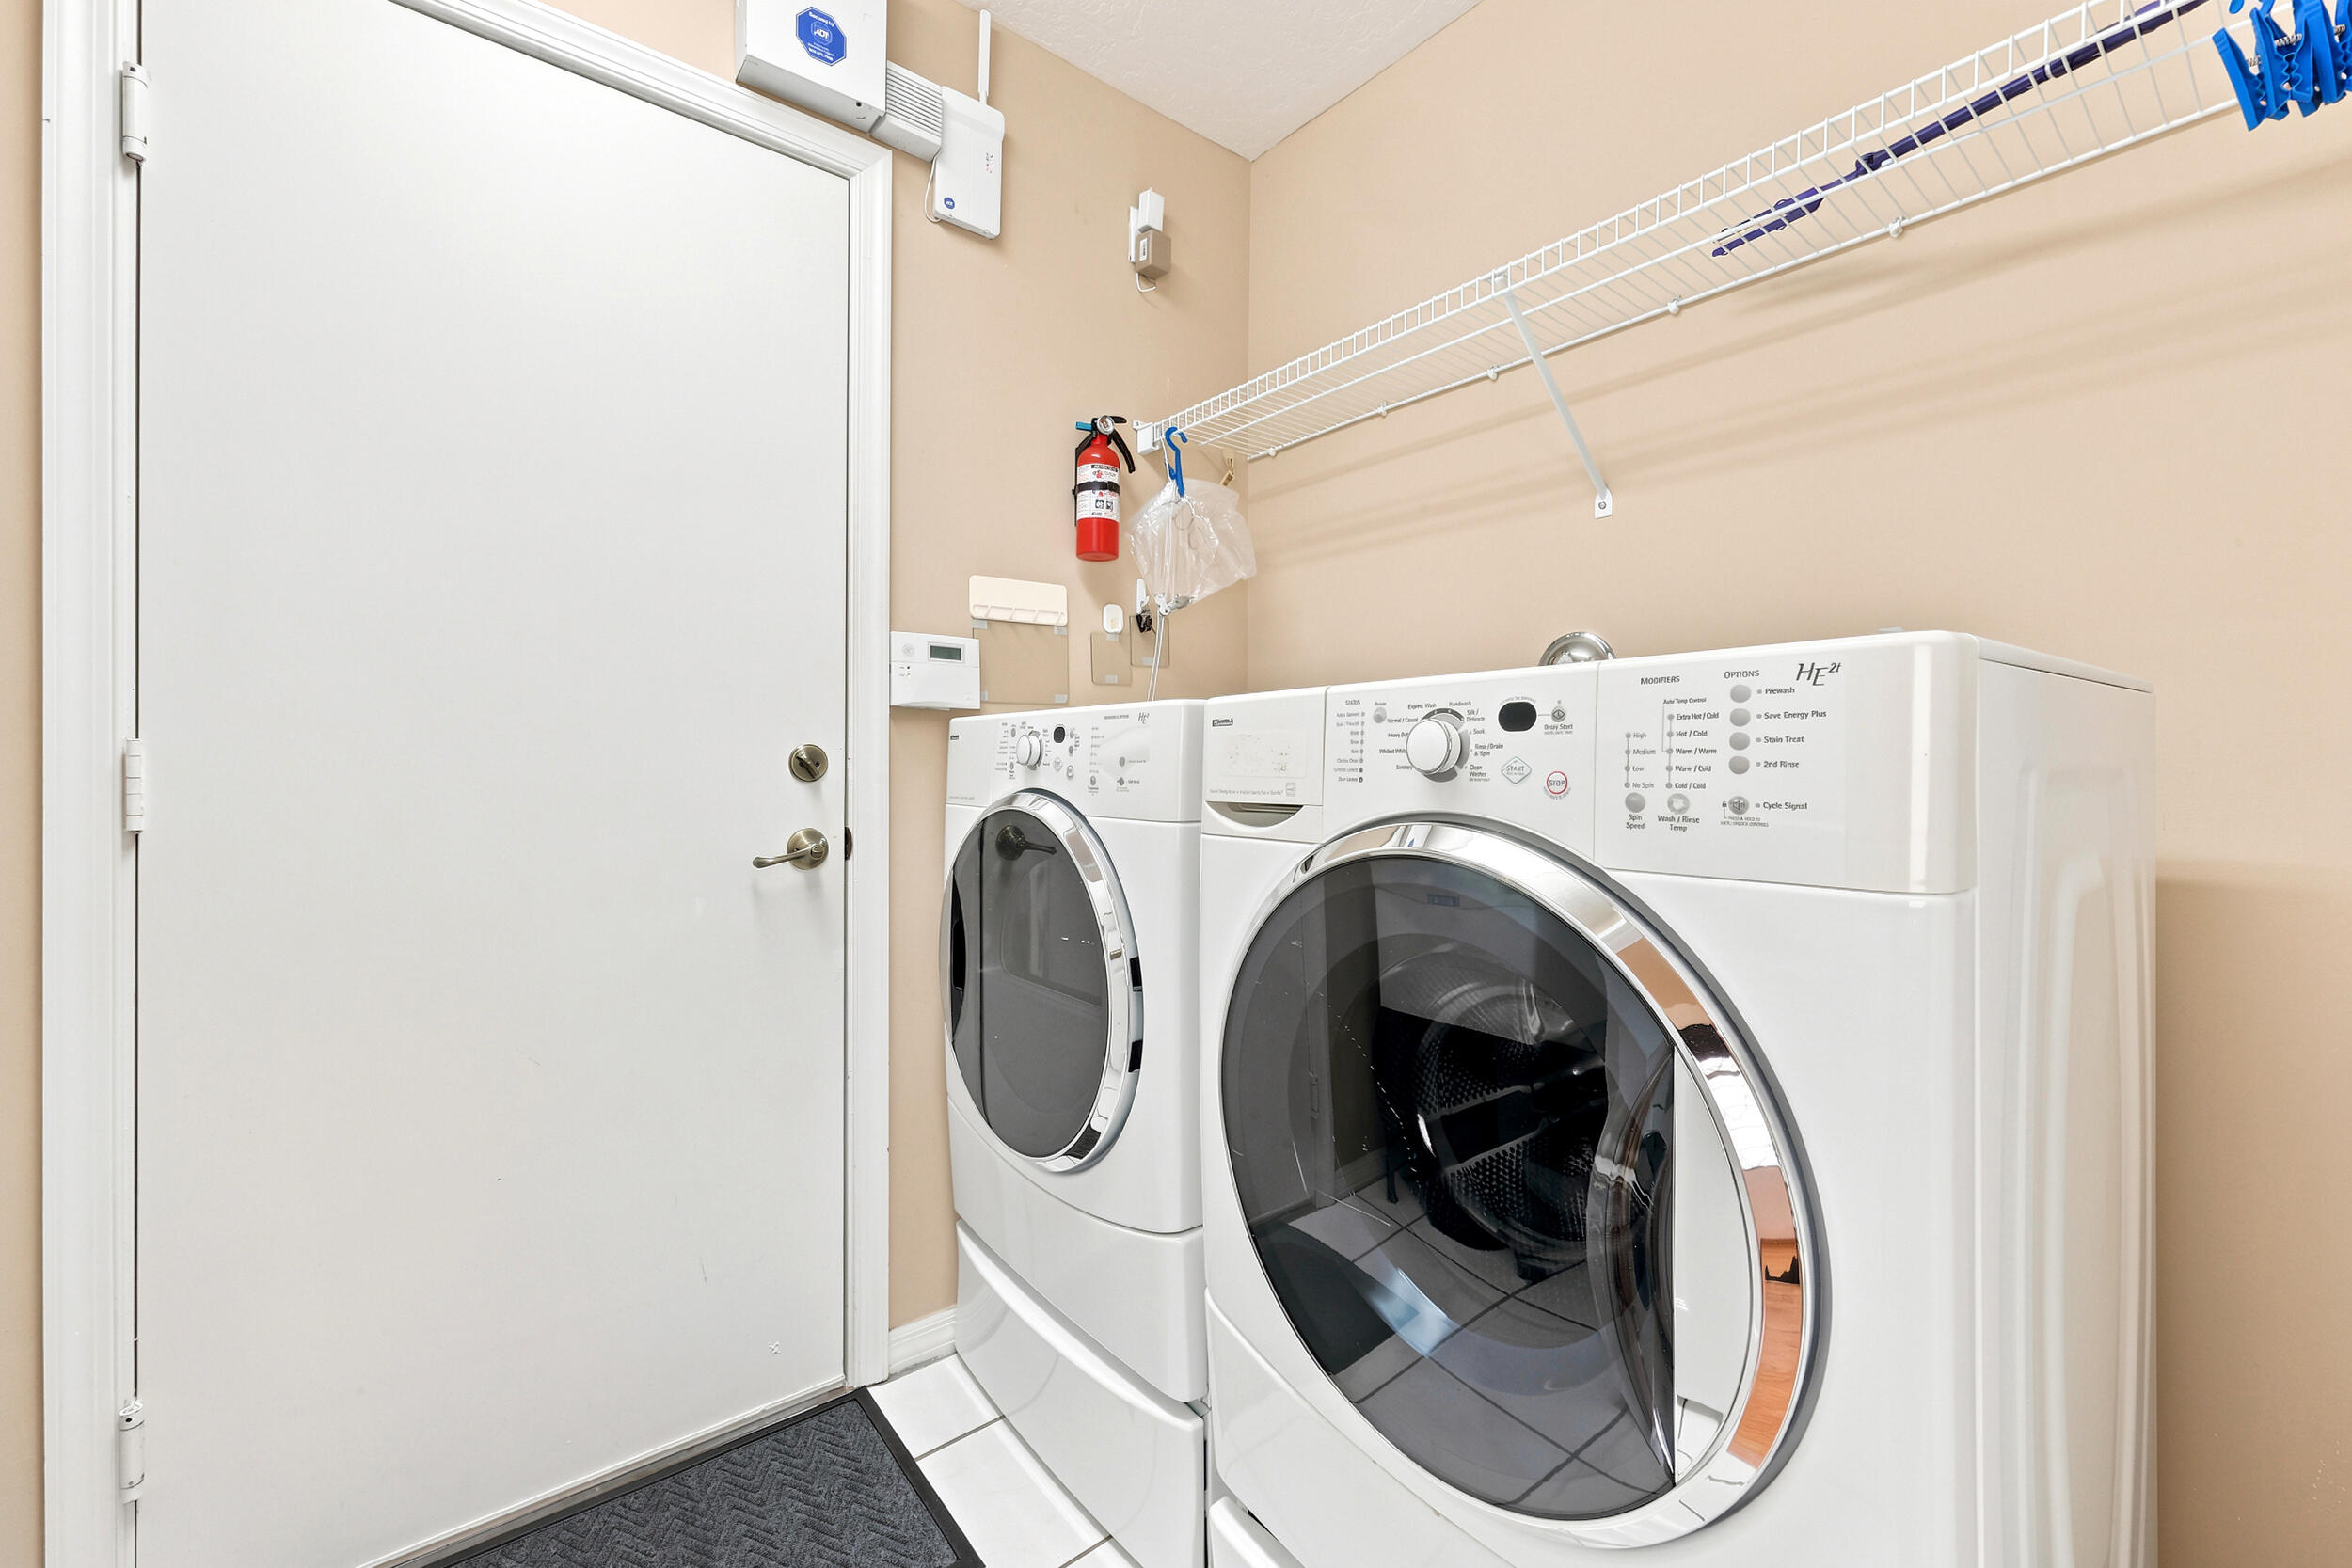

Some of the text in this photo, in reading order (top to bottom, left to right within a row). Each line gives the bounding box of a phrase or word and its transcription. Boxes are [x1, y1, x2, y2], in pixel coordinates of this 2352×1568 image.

[1724, 670, 1760, 679] OPTIONS
[1641, 675, 1680, 685] MODIFIERS
[1784, 711, 1809, 720] Energy
[1762, 801, 1808, 811] Cycle Signal
[1669, 823, 1688, 832] Temp
